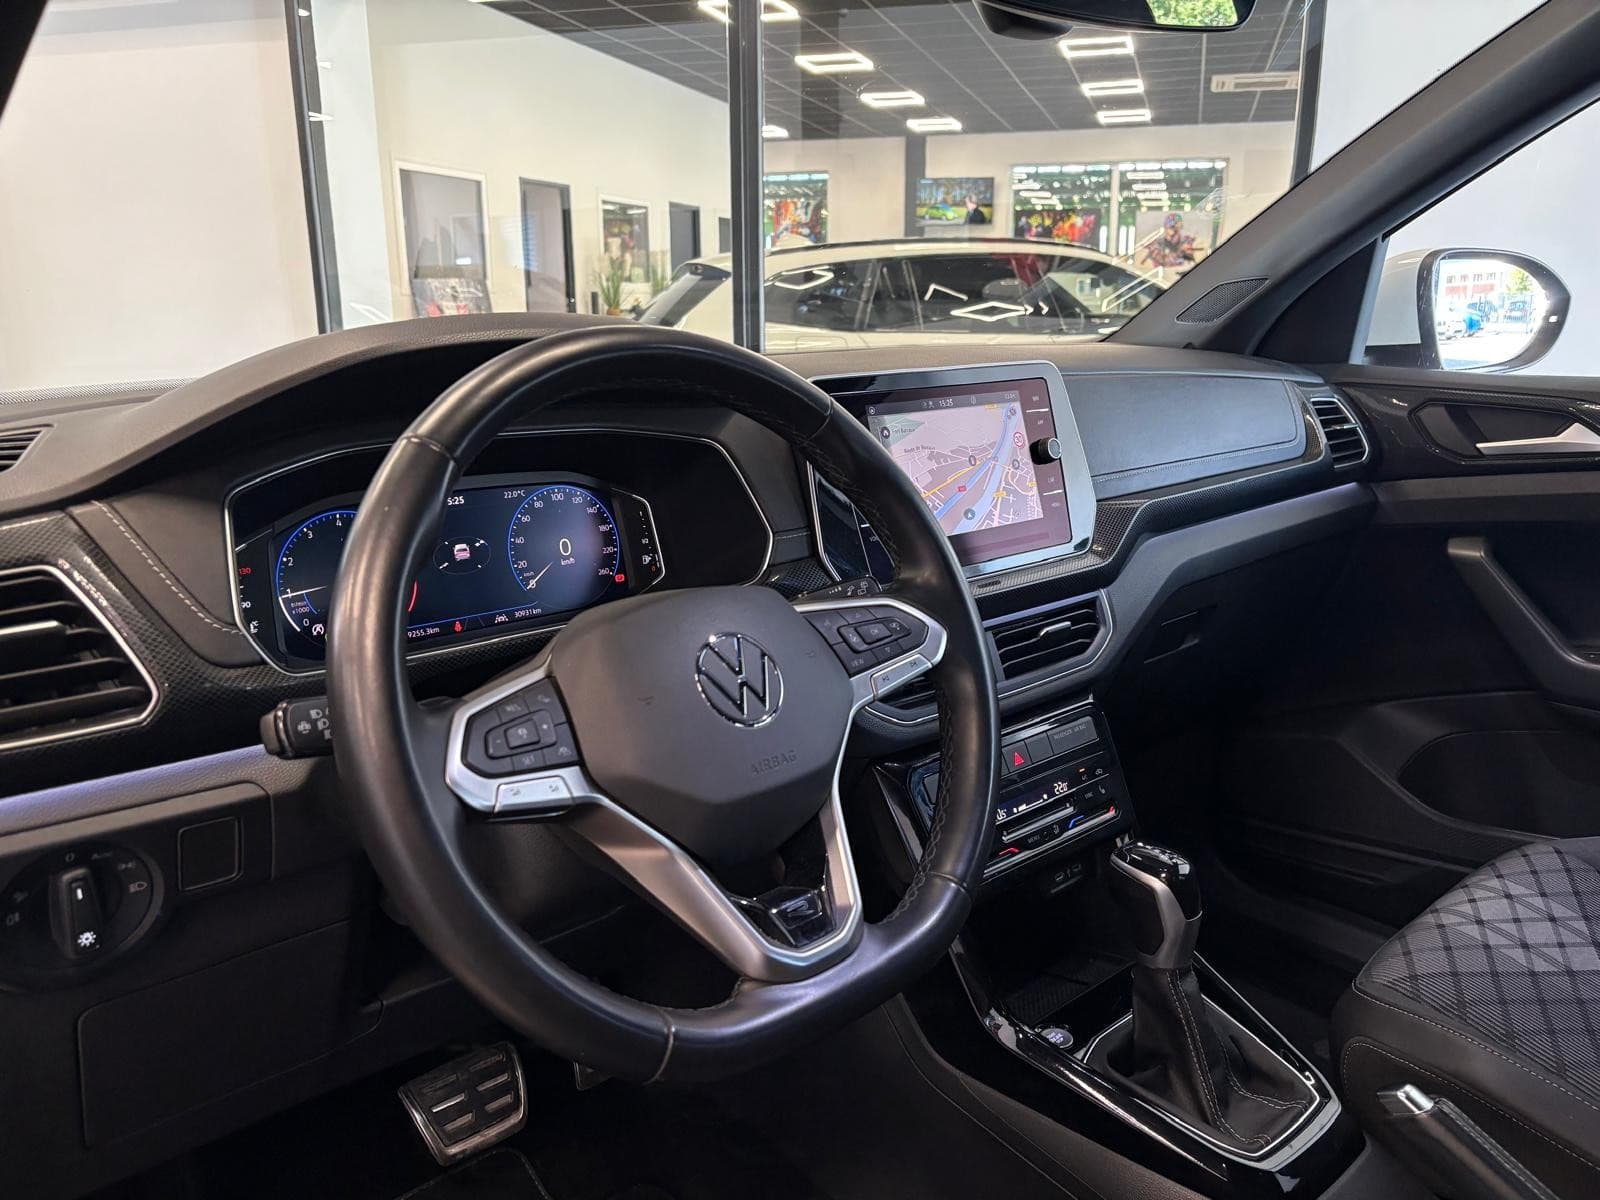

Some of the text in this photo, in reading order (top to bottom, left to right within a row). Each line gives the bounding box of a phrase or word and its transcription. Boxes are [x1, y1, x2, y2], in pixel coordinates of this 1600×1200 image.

[551, 492, 564, 501] 100
[572, 496, 583, 504] 120
[534, 501, 544, 509] 80
[586, 506, 598, 514] 140
[521, 515, 531, 523] 60
[599, 524, 610, 532] 180
[307, 530, 313, 539] 3
[559, 538, 572, 556] 0
[288, 558, 294, 567] 2
[517, 560, 528, 569] 20
[561, 557, 576, 566] km/h
[598, 567, 610, 576] 260
[303, 618, 309, 626] 0
[751, 749, 798, 776] AIRBAG
